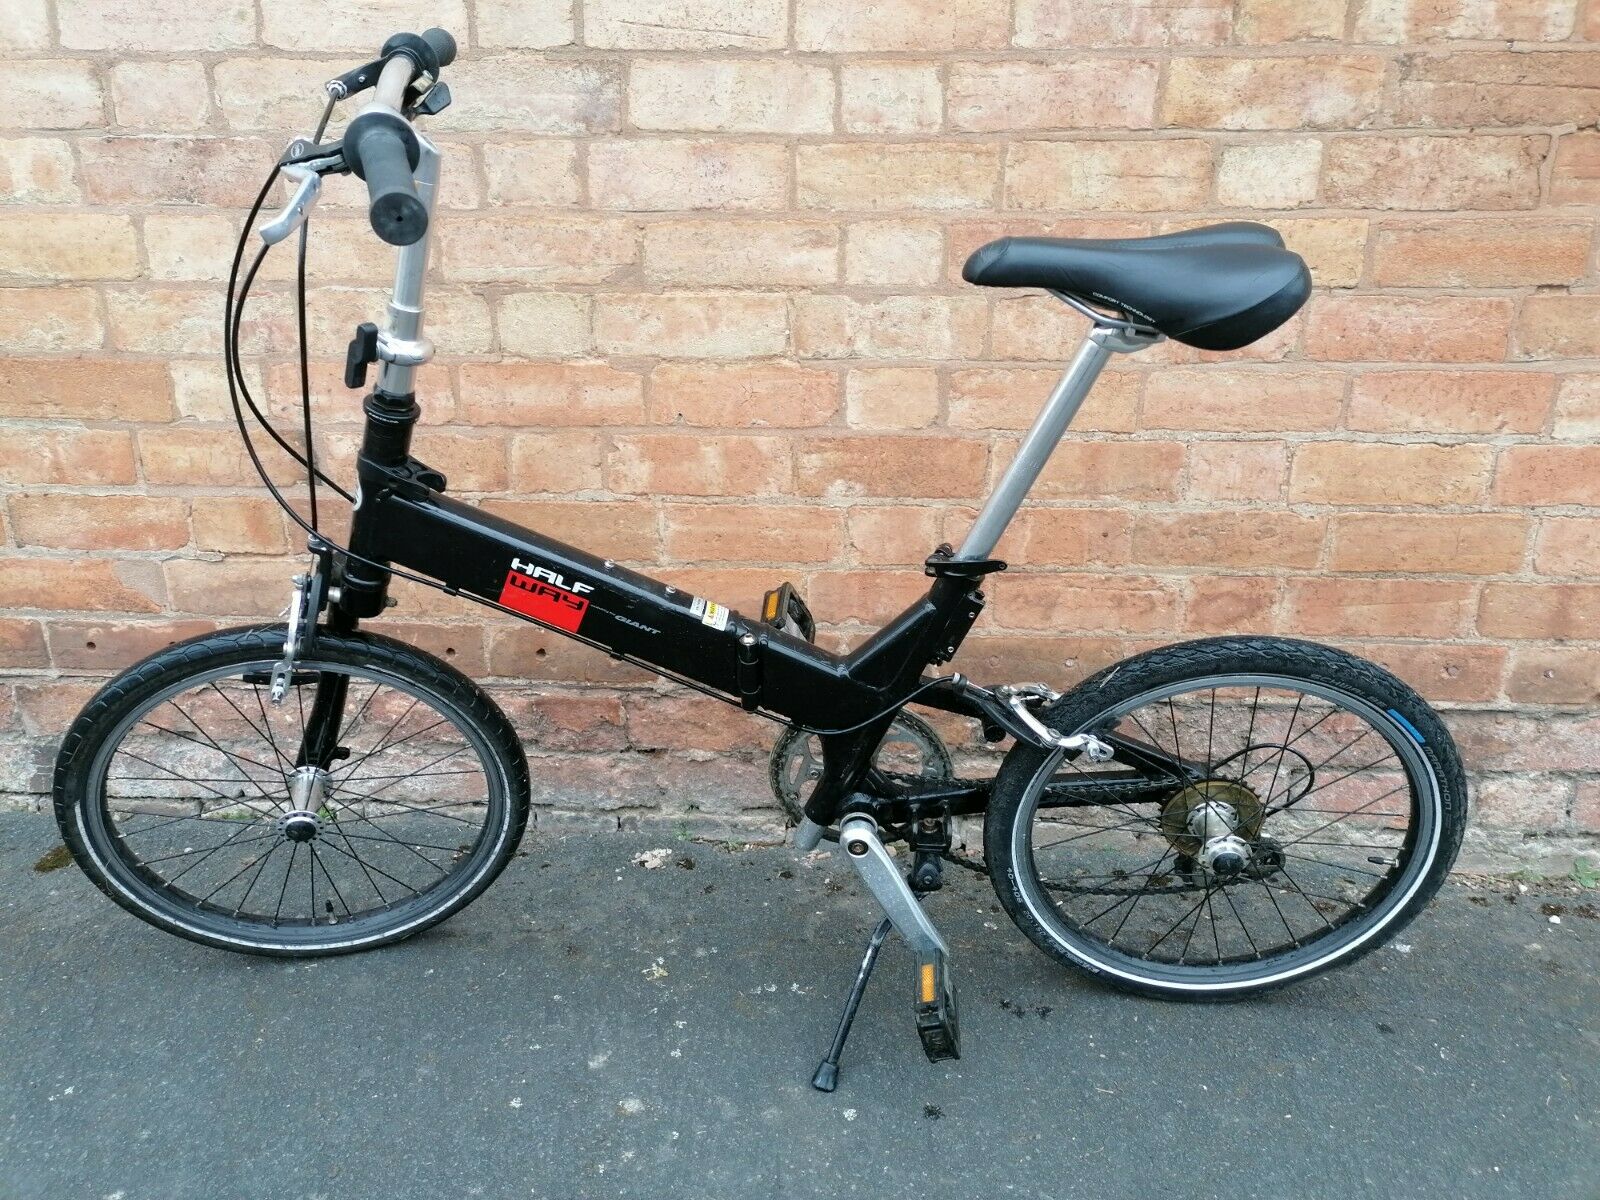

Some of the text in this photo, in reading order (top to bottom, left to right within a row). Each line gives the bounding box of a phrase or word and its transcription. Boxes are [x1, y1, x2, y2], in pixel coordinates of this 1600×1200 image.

[509, 574, 585, 611] WAY
[510, 557, 595, 594] HALF
[614, 614, 662, 635] GIANT
[1424, 745, 1452, 810] MARATHON
